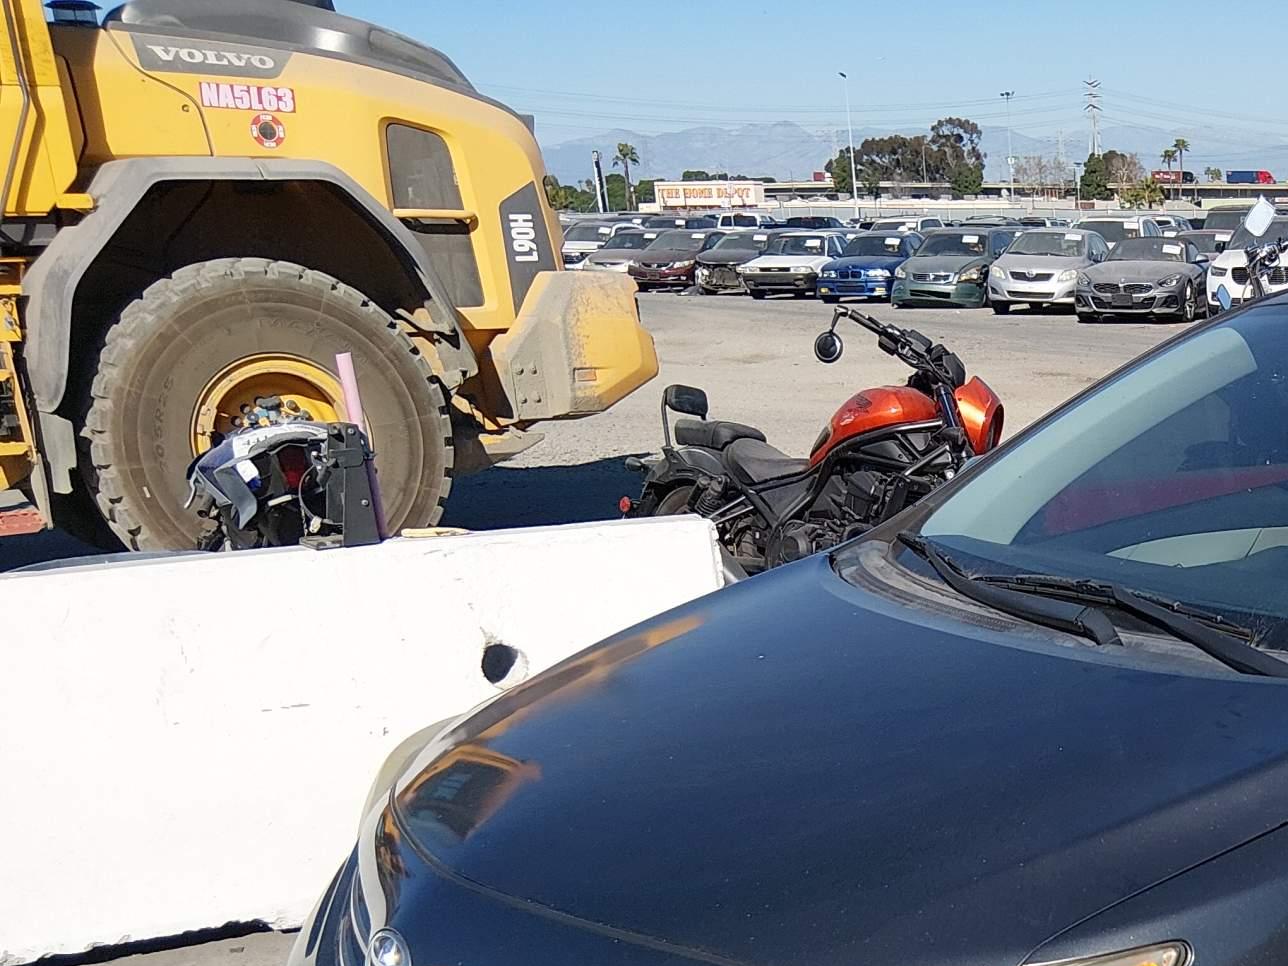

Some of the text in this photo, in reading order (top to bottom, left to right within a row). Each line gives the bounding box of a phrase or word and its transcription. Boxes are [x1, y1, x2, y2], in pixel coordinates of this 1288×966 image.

[146, 45, 275, 69] VOLVO
[201, 82, 295, 112] NA5L63
[658, 187, 751, 199] THE HOME DEPOT
[508, 213, 539, 262] L90H
